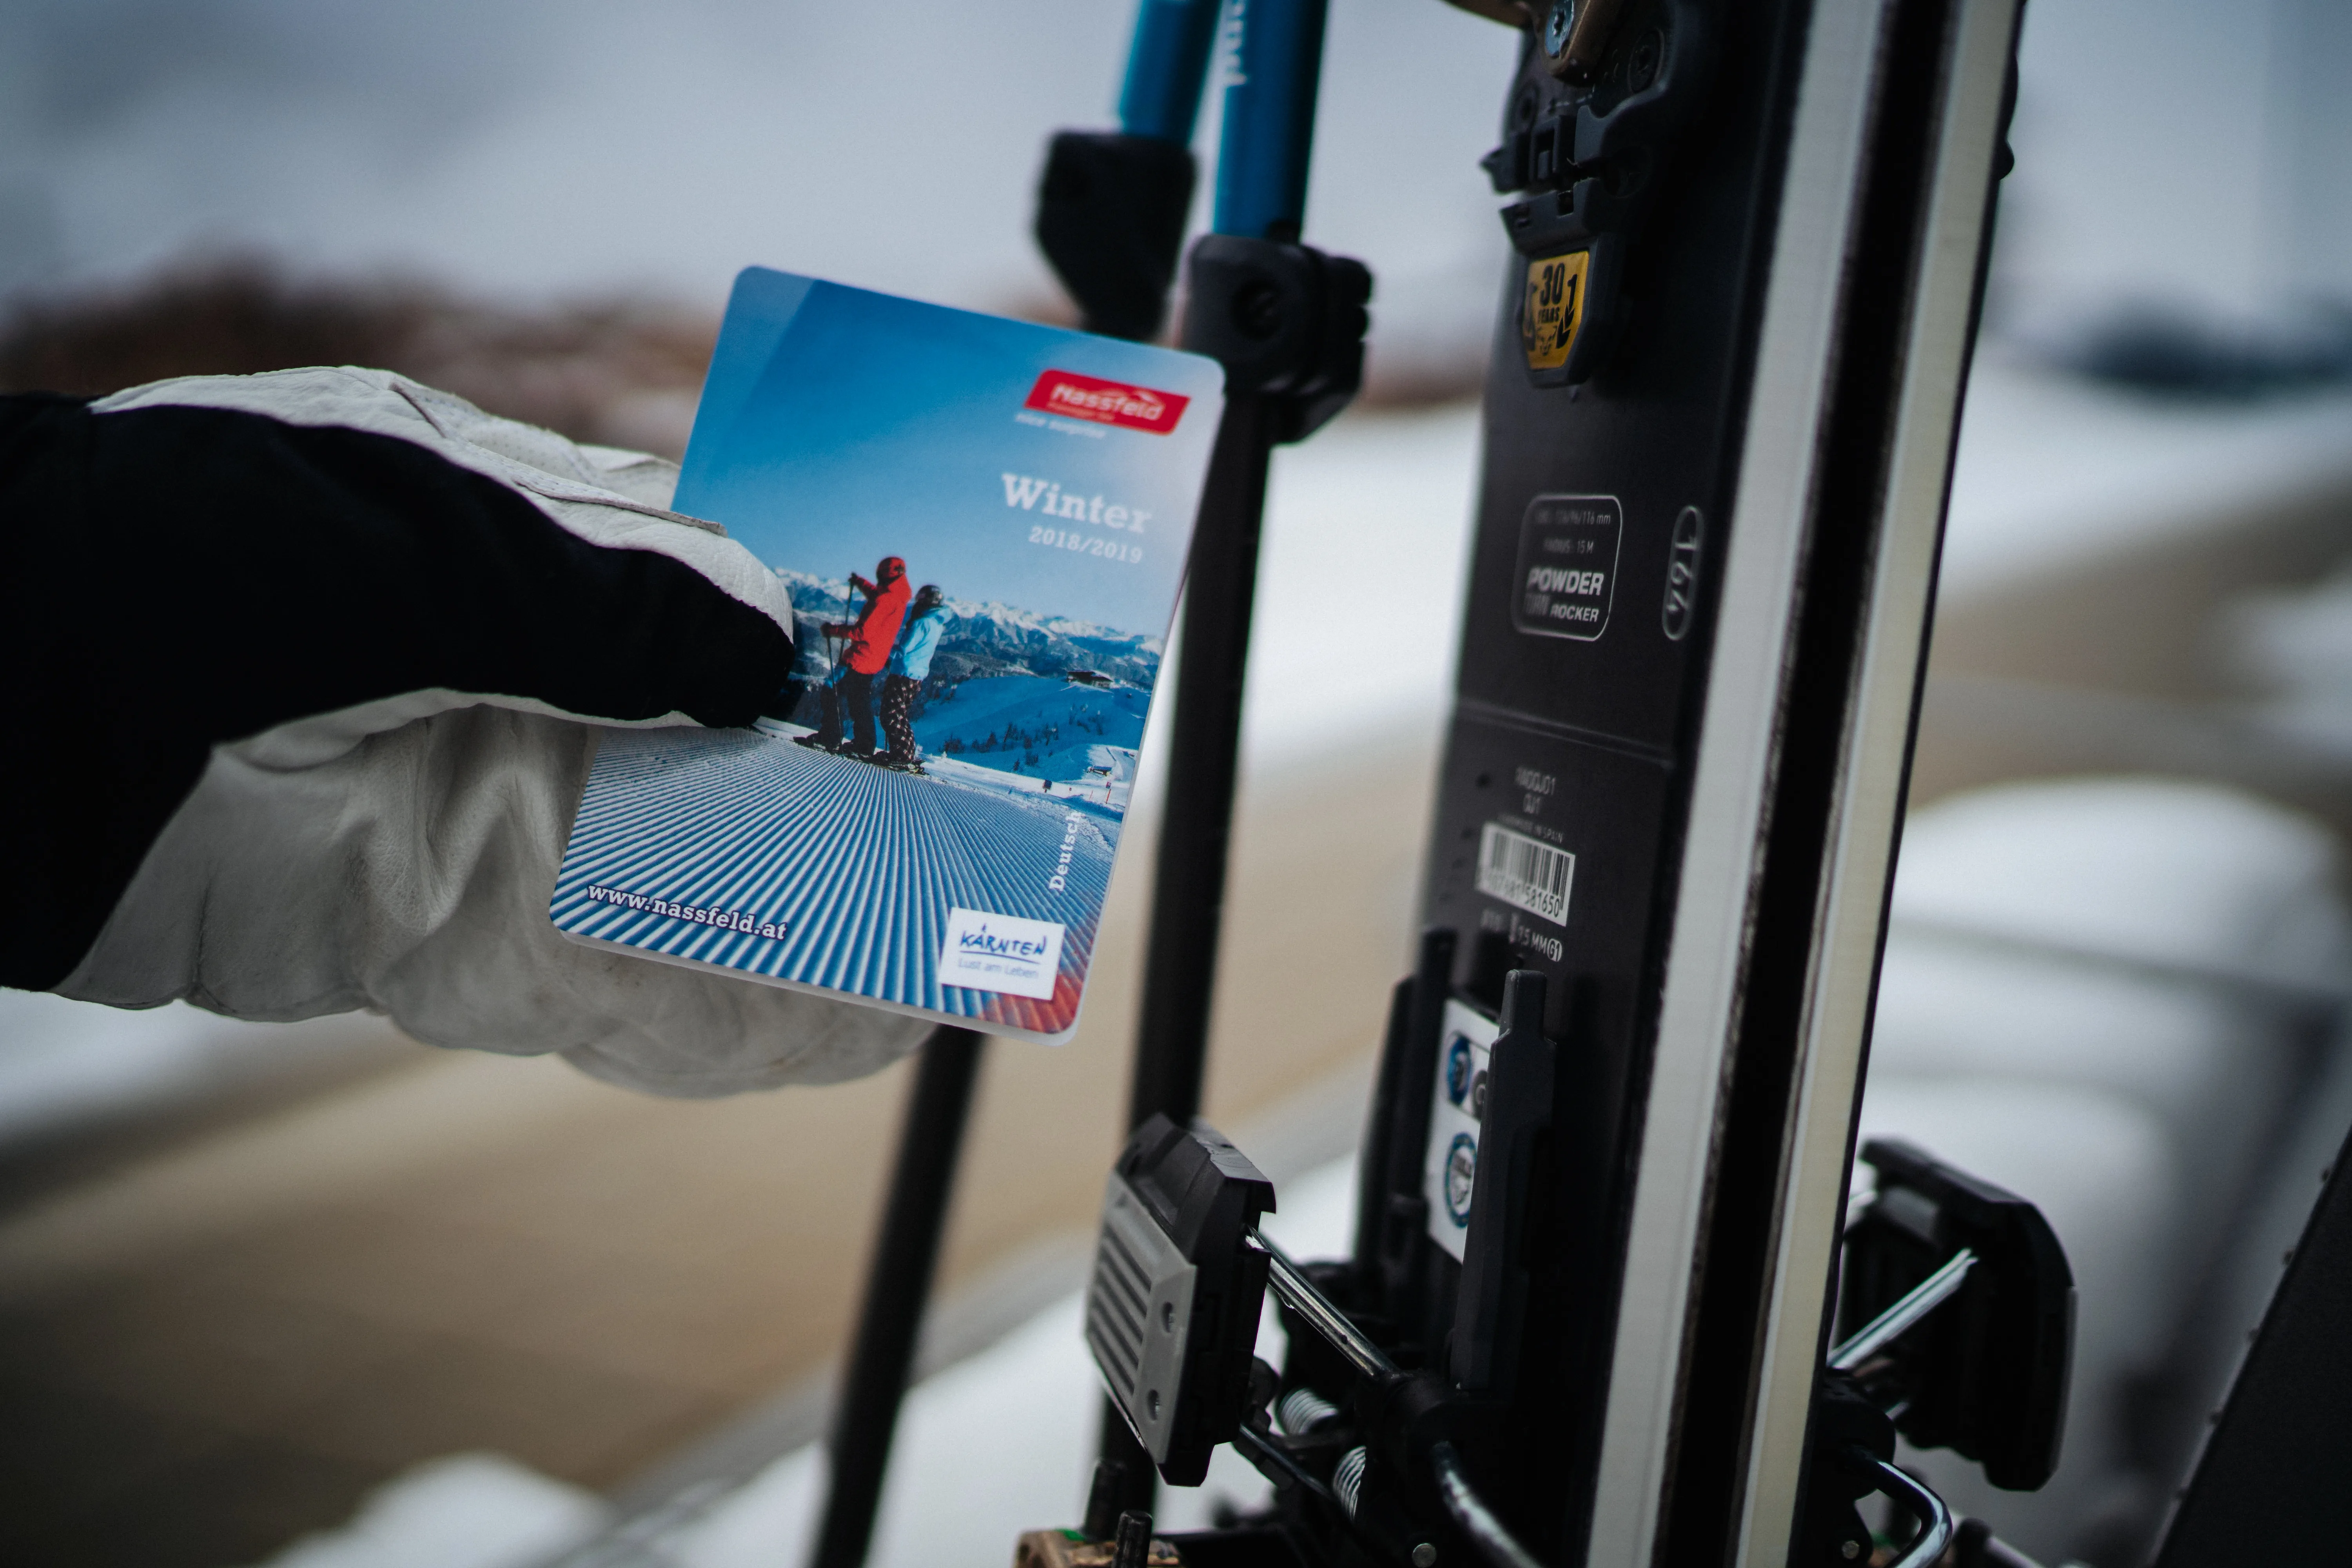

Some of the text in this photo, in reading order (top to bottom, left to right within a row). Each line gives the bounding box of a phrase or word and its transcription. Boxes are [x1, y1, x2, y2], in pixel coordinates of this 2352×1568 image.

[1539, 262, 1565, 306] 30
[1049, 383, 1167, 421] Nassfeld
[1002, 472, 1152, 534] Winter
[1028, 524, 1143, 564] 2018/2019
[1528, 567, 1604, 596] POWDER
[1550, 603, 1599, 622] ROCKER
[1049, 811, 1083, 892] Deutsch
[588, 884, 788, 940] www.nassfeld.at
[958, 958, 1039, 979] Lust am Leben
